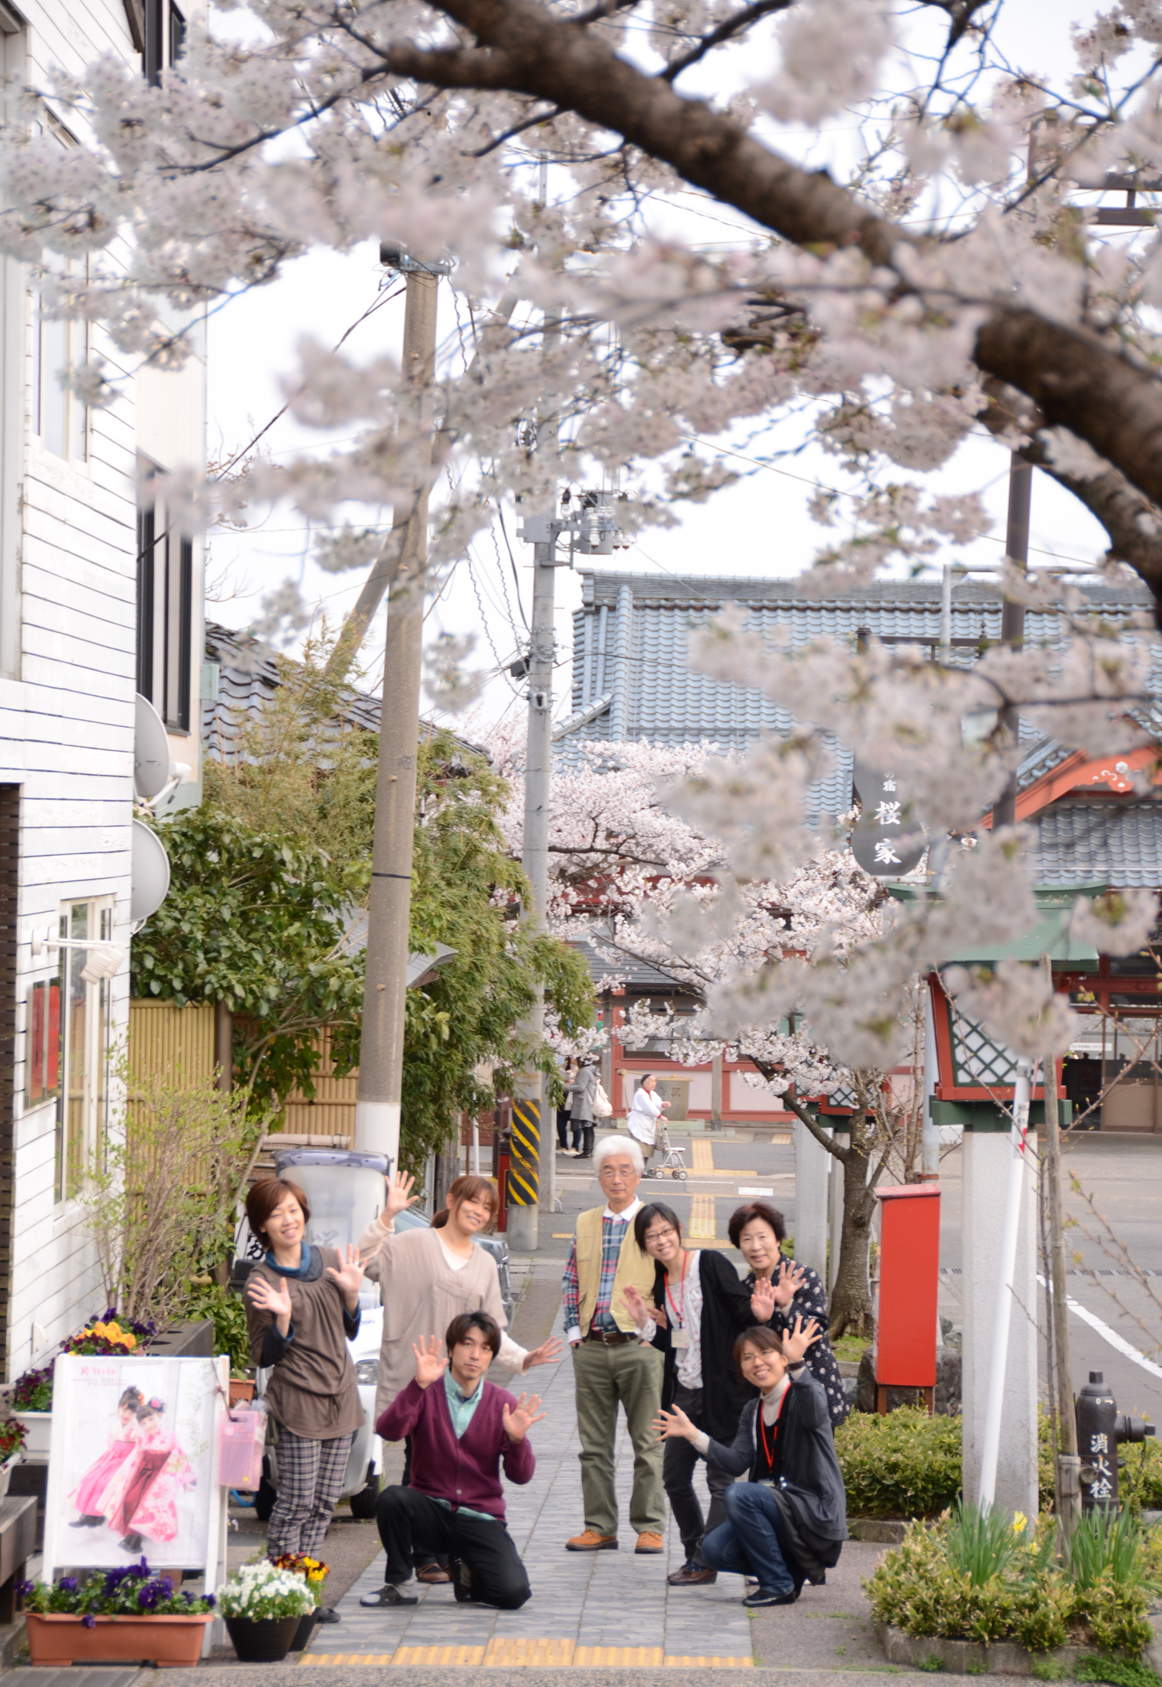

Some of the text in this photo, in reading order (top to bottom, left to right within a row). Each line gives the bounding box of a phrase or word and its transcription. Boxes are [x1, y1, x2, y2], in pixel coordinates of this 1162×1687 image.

[874, 801, 902, 864] 桜家
[1090, 1433, 1113, 1499] 消火栓
